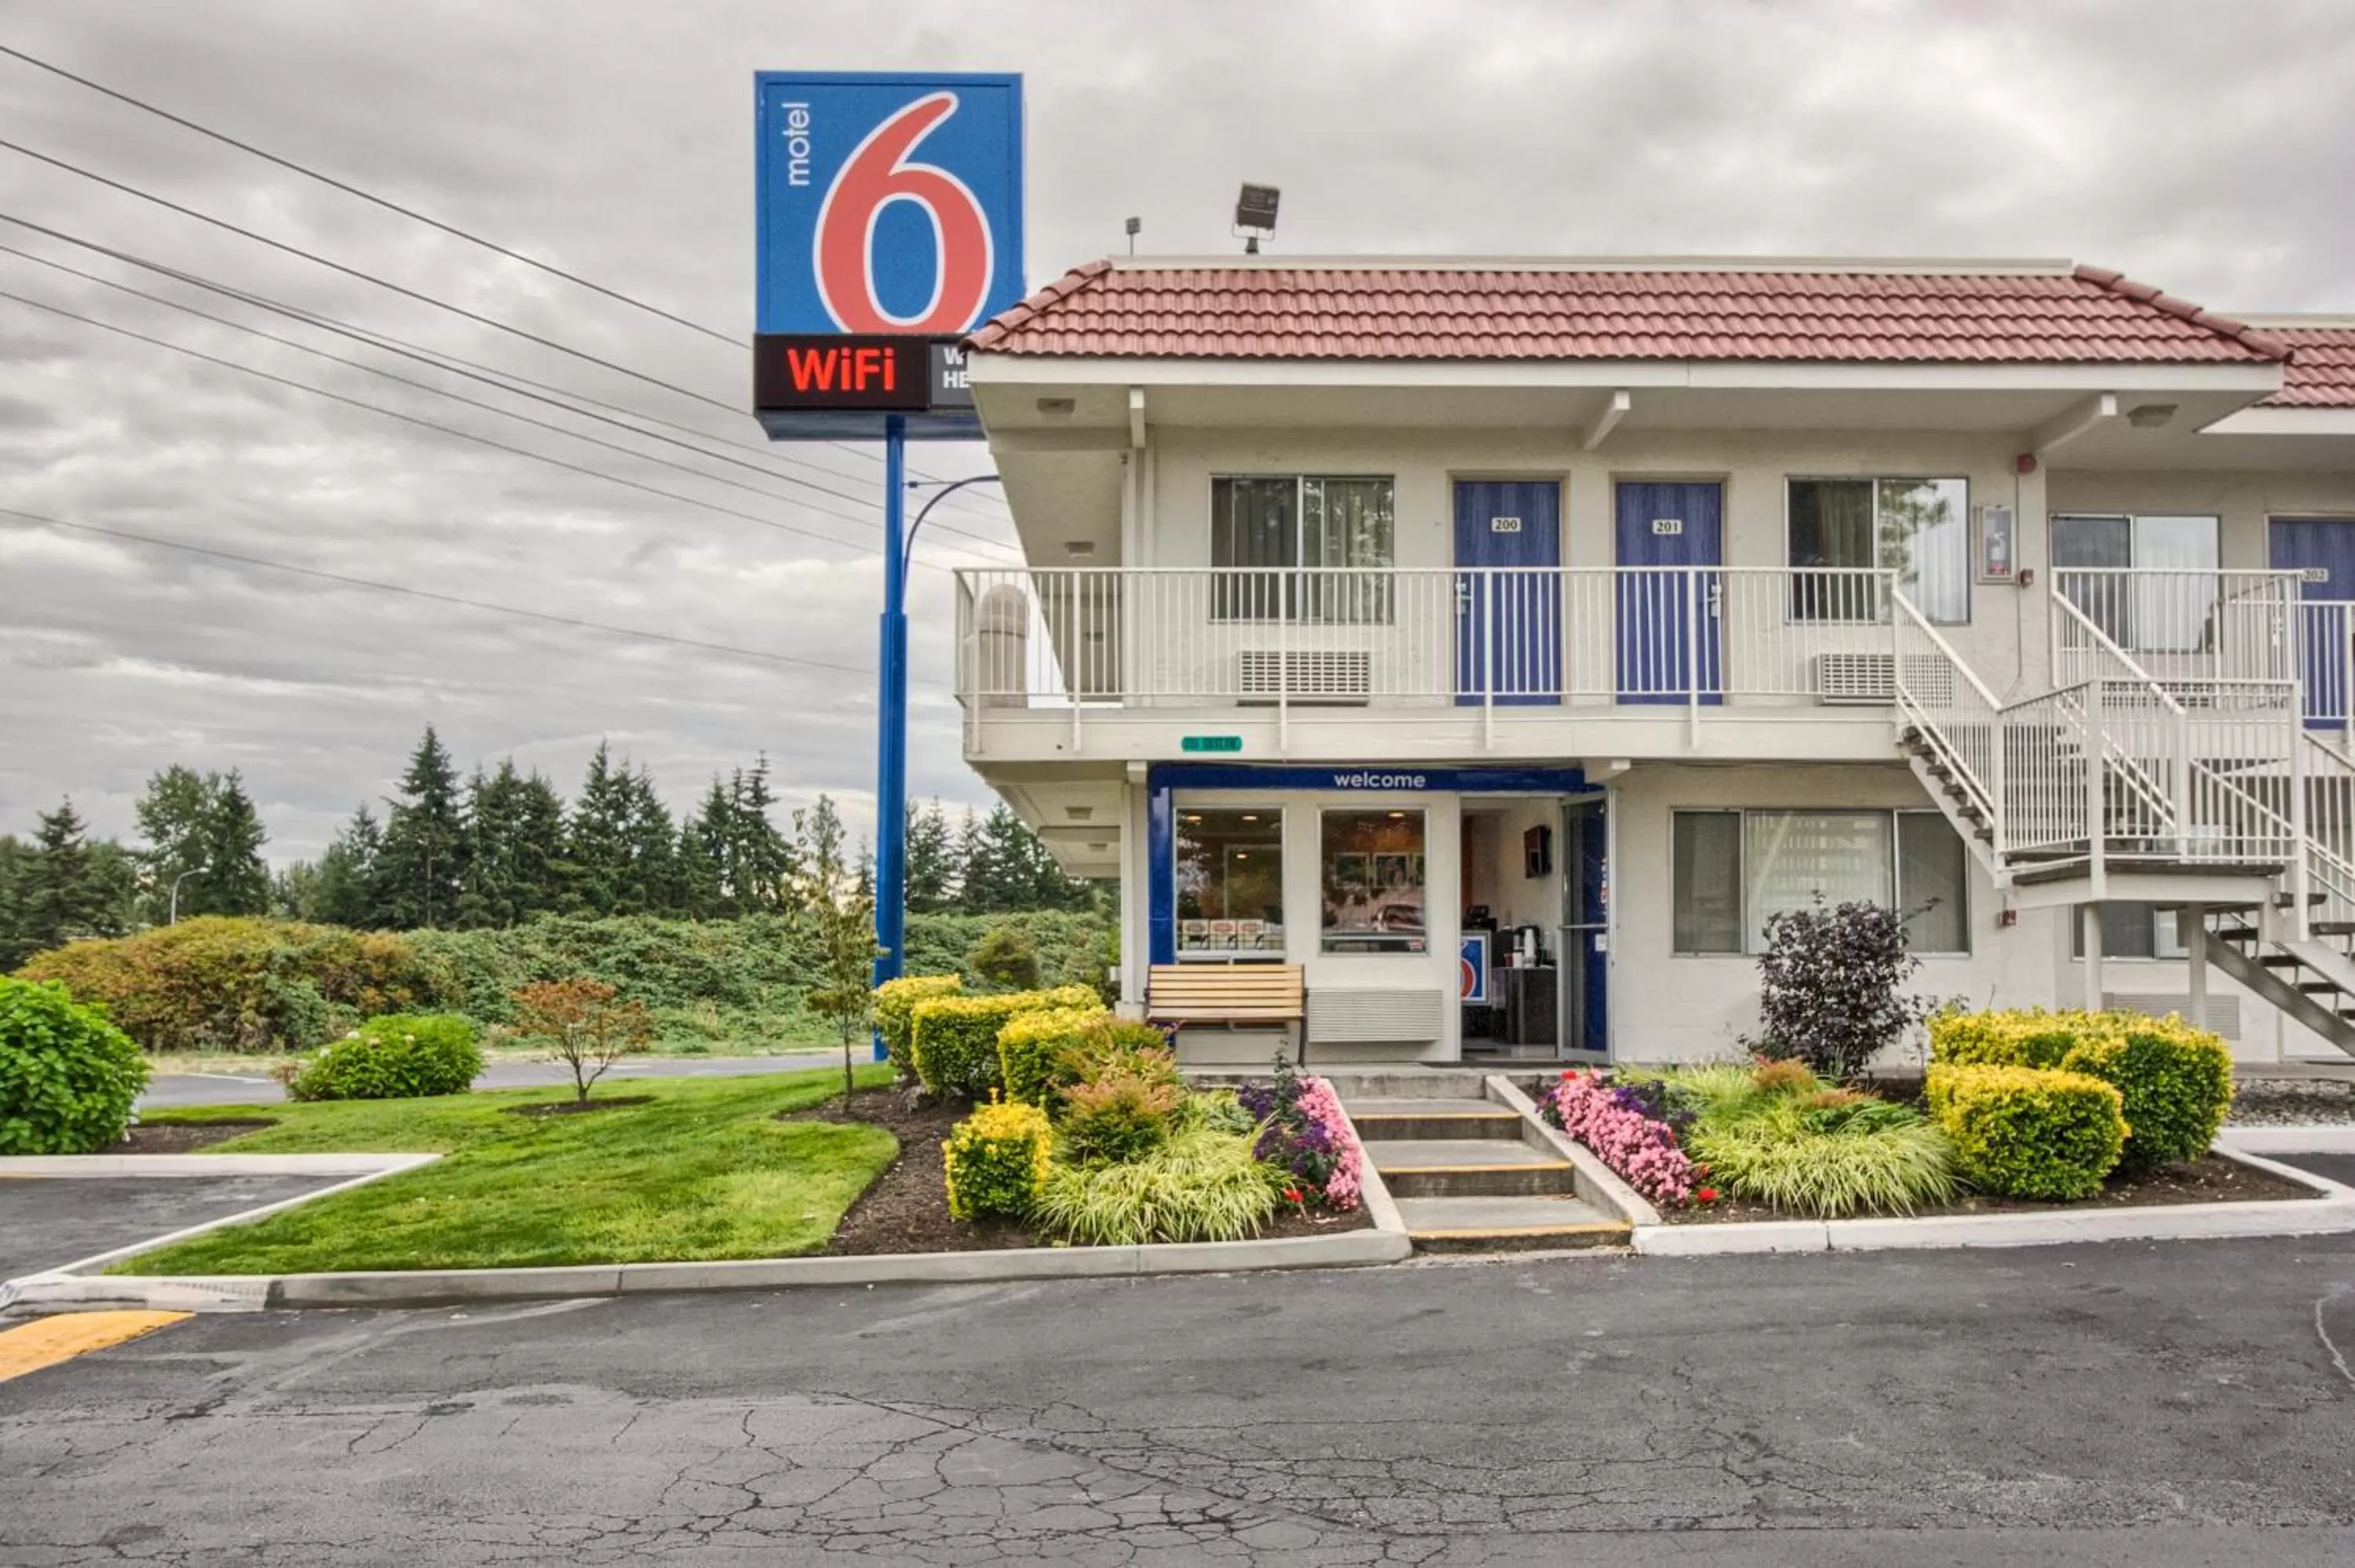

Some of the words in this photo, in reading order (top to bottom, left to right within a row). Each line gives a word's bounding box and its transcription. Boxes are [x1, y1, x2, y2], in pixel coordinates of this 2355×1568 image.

[781, 102, 810, 185] motel
[813, 91, 994, 334] 6
[787, 347, 895, 391] WiFi
[1495, 519, 1517, 530] 200
[1656, 521, 1678, 532] 201
[1334, 771, 1426, 788] welcome
